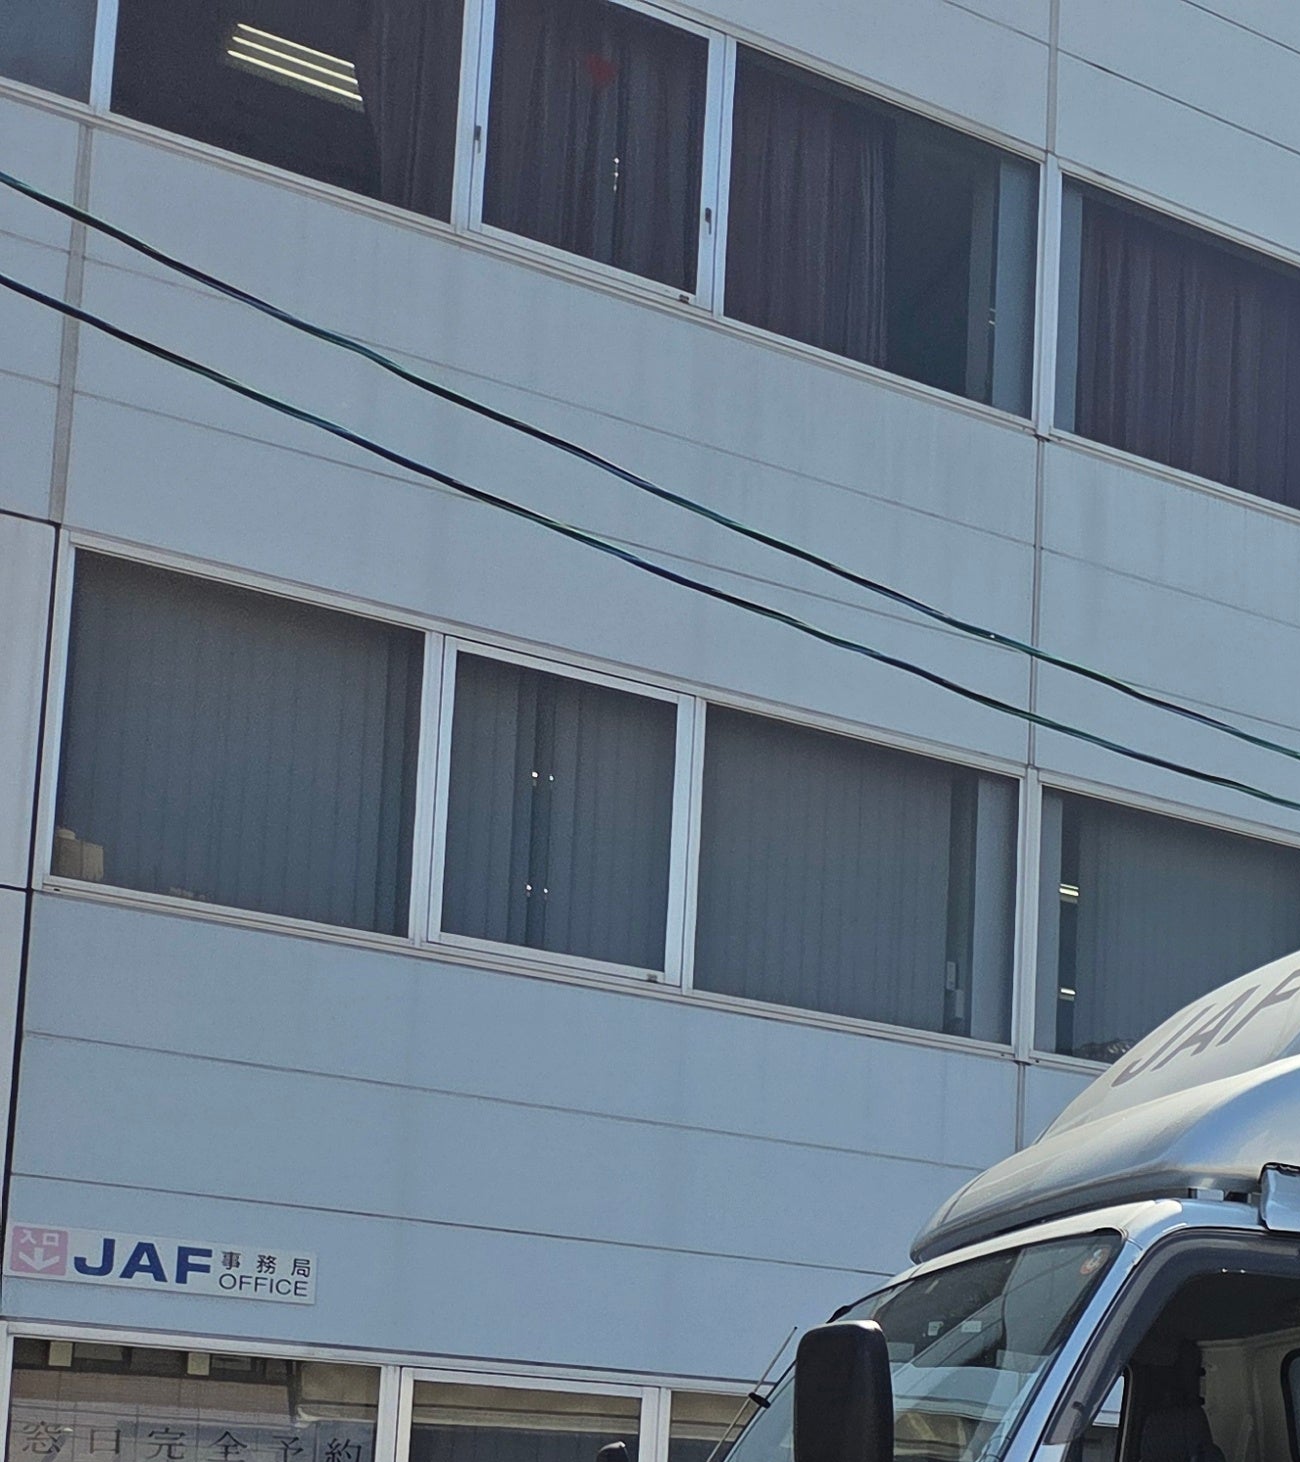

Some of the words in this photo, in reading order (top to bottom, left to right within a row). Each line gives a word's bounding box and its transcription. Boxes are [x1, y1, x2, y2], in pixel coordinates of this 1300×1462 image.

[19, 1228, 60, 1248] 入口
[73, 1237, 213, 1285] JAF
[221, 1251, 312, 1278] 事務局
[218, 1273, 309, 1298] OFFICE
